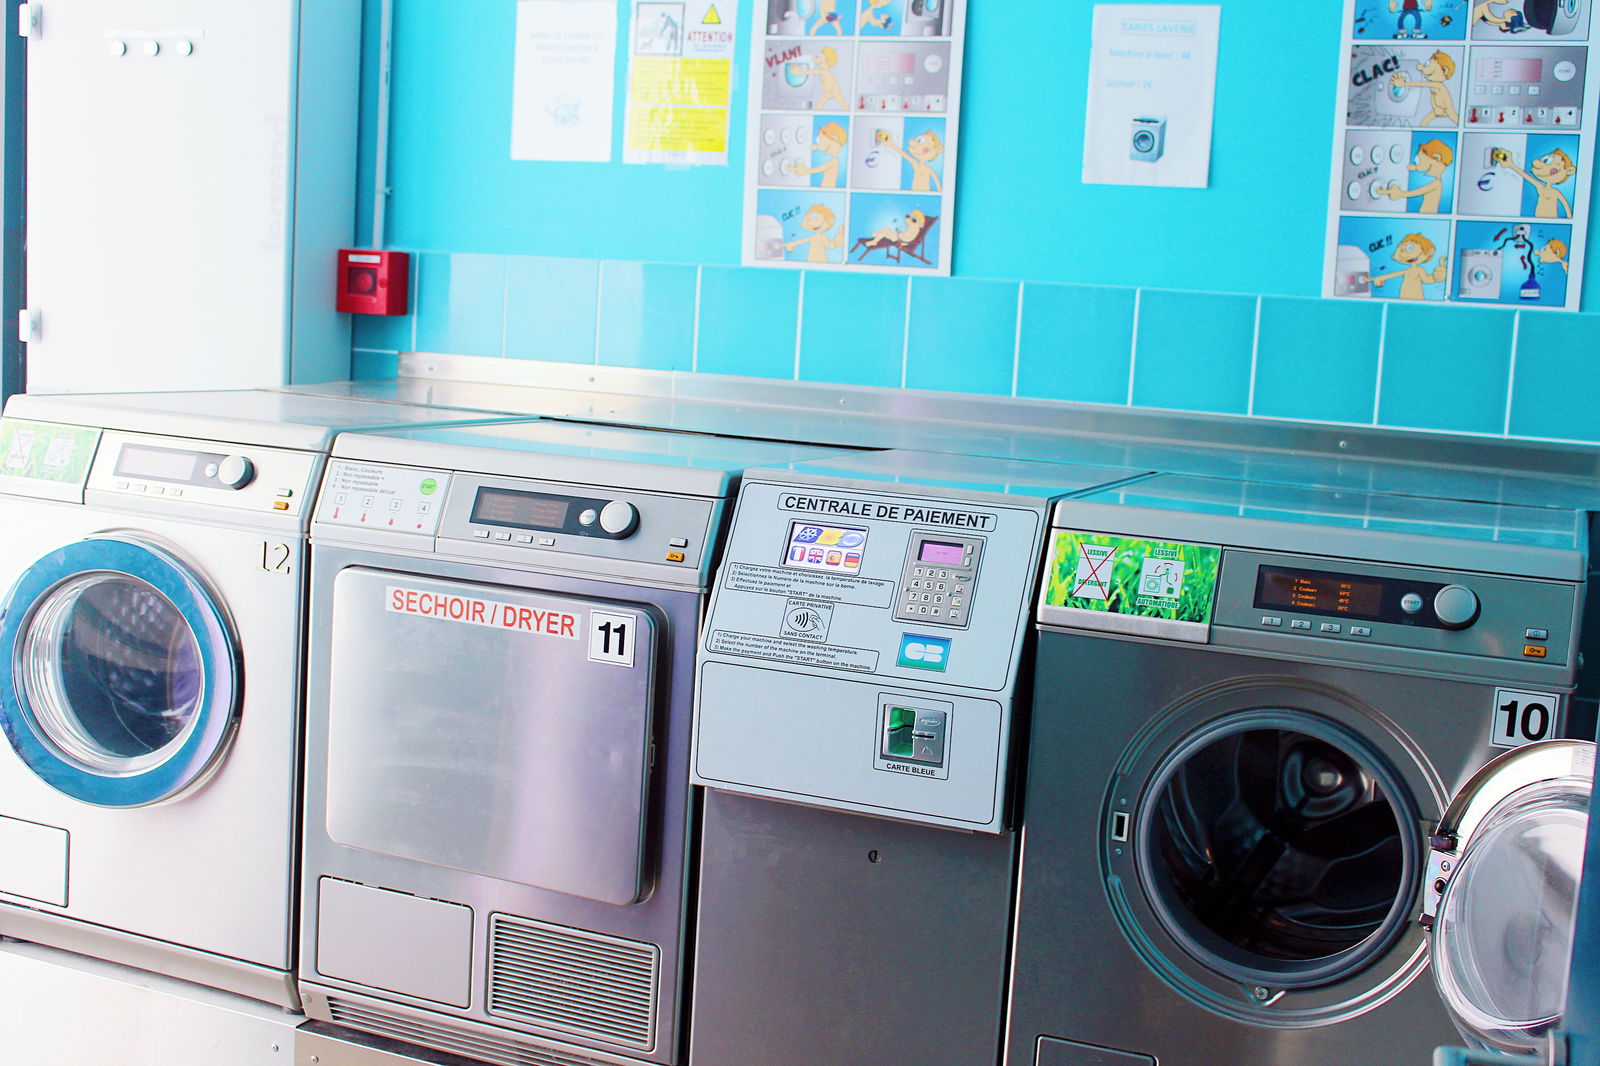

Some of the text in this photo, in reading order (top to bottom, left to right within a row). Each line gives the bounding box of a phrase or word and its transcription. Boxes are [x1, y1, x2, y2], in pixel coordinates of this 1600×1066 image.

[687, 31, 733, 43] ATTENTION
[1352, 55, 1400, 87] CLAC!
[1368, 238, 1384, 253] CLIC
[784, 495, 990, 529] CENTRALE DE PAIEMENT
[1154, 548, 1179, 558] LESSIVE
[739, 564, 758, 572] Chargez
[735, 577, 758, 585] Effectuez
[1136, 597, 1180, 610] AUTOMATIQUE
[391, 589, 576, 637] SECHOIR / DRYER
[597, 621, 626, 656] 11
[722, 632, 740, 640] Charge
[751, 636, 772, 644] machine
[807, 644, 827, 652] washing
[798, 632, 823, 640] CONTACT
[1499, 700, 1549, 741] 10
[886, 763, 936, 776] CARTE BLEUE
